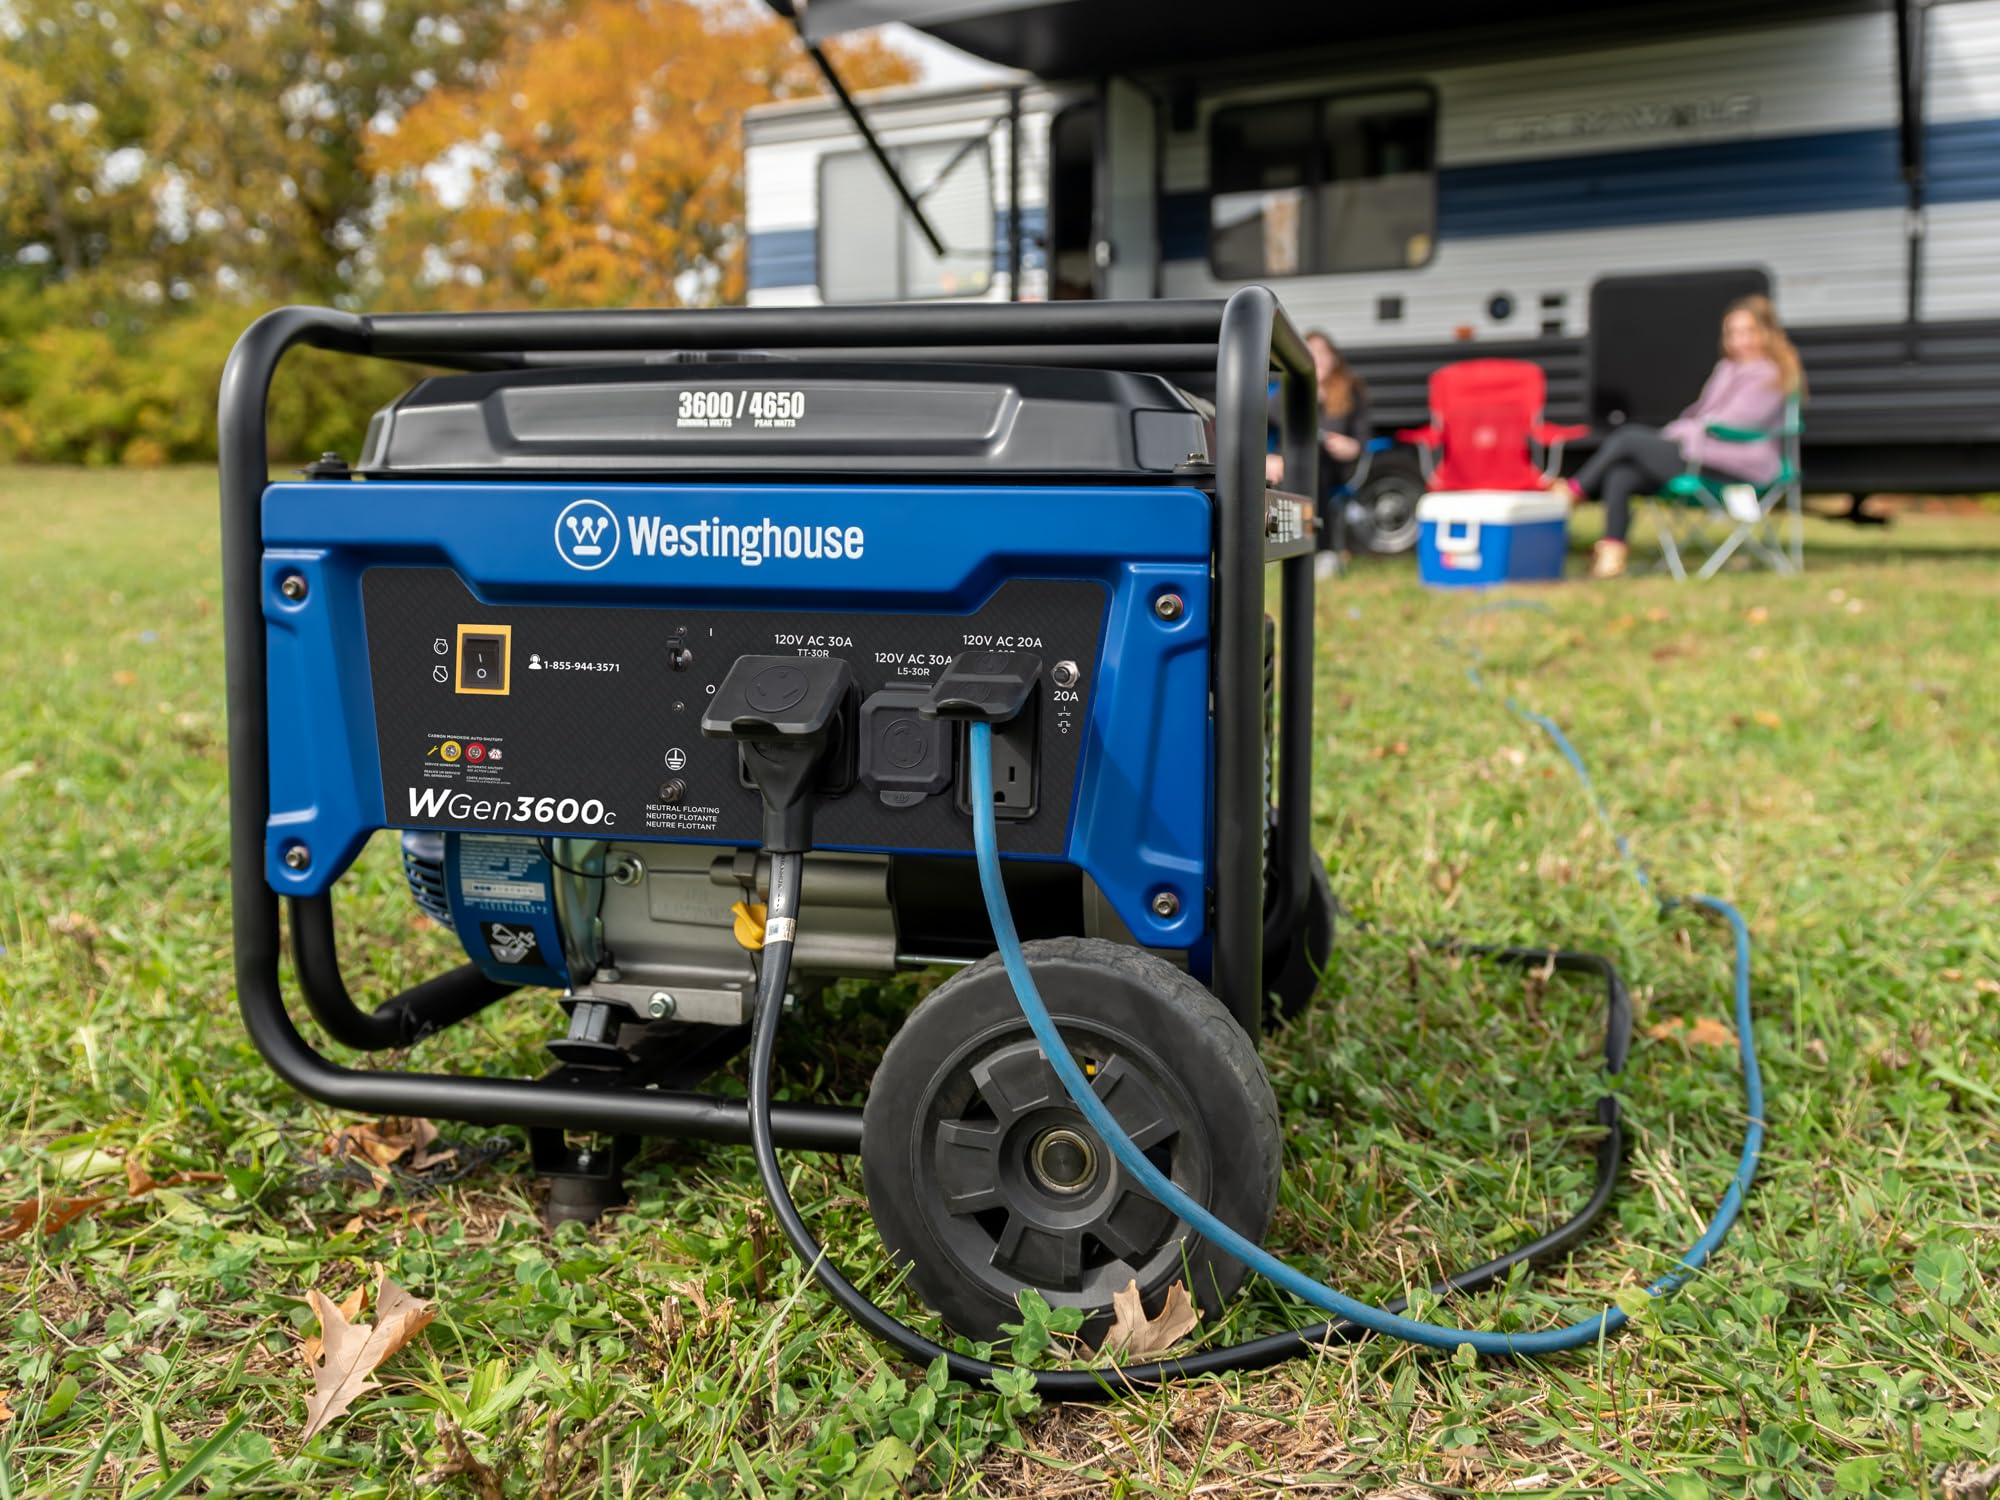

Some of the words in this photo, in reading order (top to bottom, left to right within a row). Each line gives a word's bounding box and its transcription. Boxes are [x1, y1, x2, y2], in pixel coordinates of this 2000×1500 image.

[679, 391, 733, 418] 3600
[749, 391, 805, 419] 4650
[627, 516, 864, 566] Westinghouse
[774, 634, 804, 646] 120V
[807, 635, 824, 646] AC
[828, 636, 853, 647] 30A
[963, 635, 992, 646] 120V
[996, 636, 1014, 647] AC
[1017, 637, 1043, 648] 20A
[797, 648, 830, 657] TT-30R
[874, 652, 904, 664] 120V
[907, 653, 925, 664] AC
[928, 654, 952, 665] 30A
[543, 660, 620, 672] 1-855-944-3571
[897, 667, 930, 676] L5-30R
[1053, 690, 1079, 702] 20A
[646, 804, 681, 812] NEUTRAL
[683, 806, 720, 814] FLOATING
[646, 812, 677, 820] NEUTRO
[679, 814, 718, 822] FLOTANTE
[646, 821, 676, 829] NEUTRE
[677, 822, 716, 830] FLOTTANT
